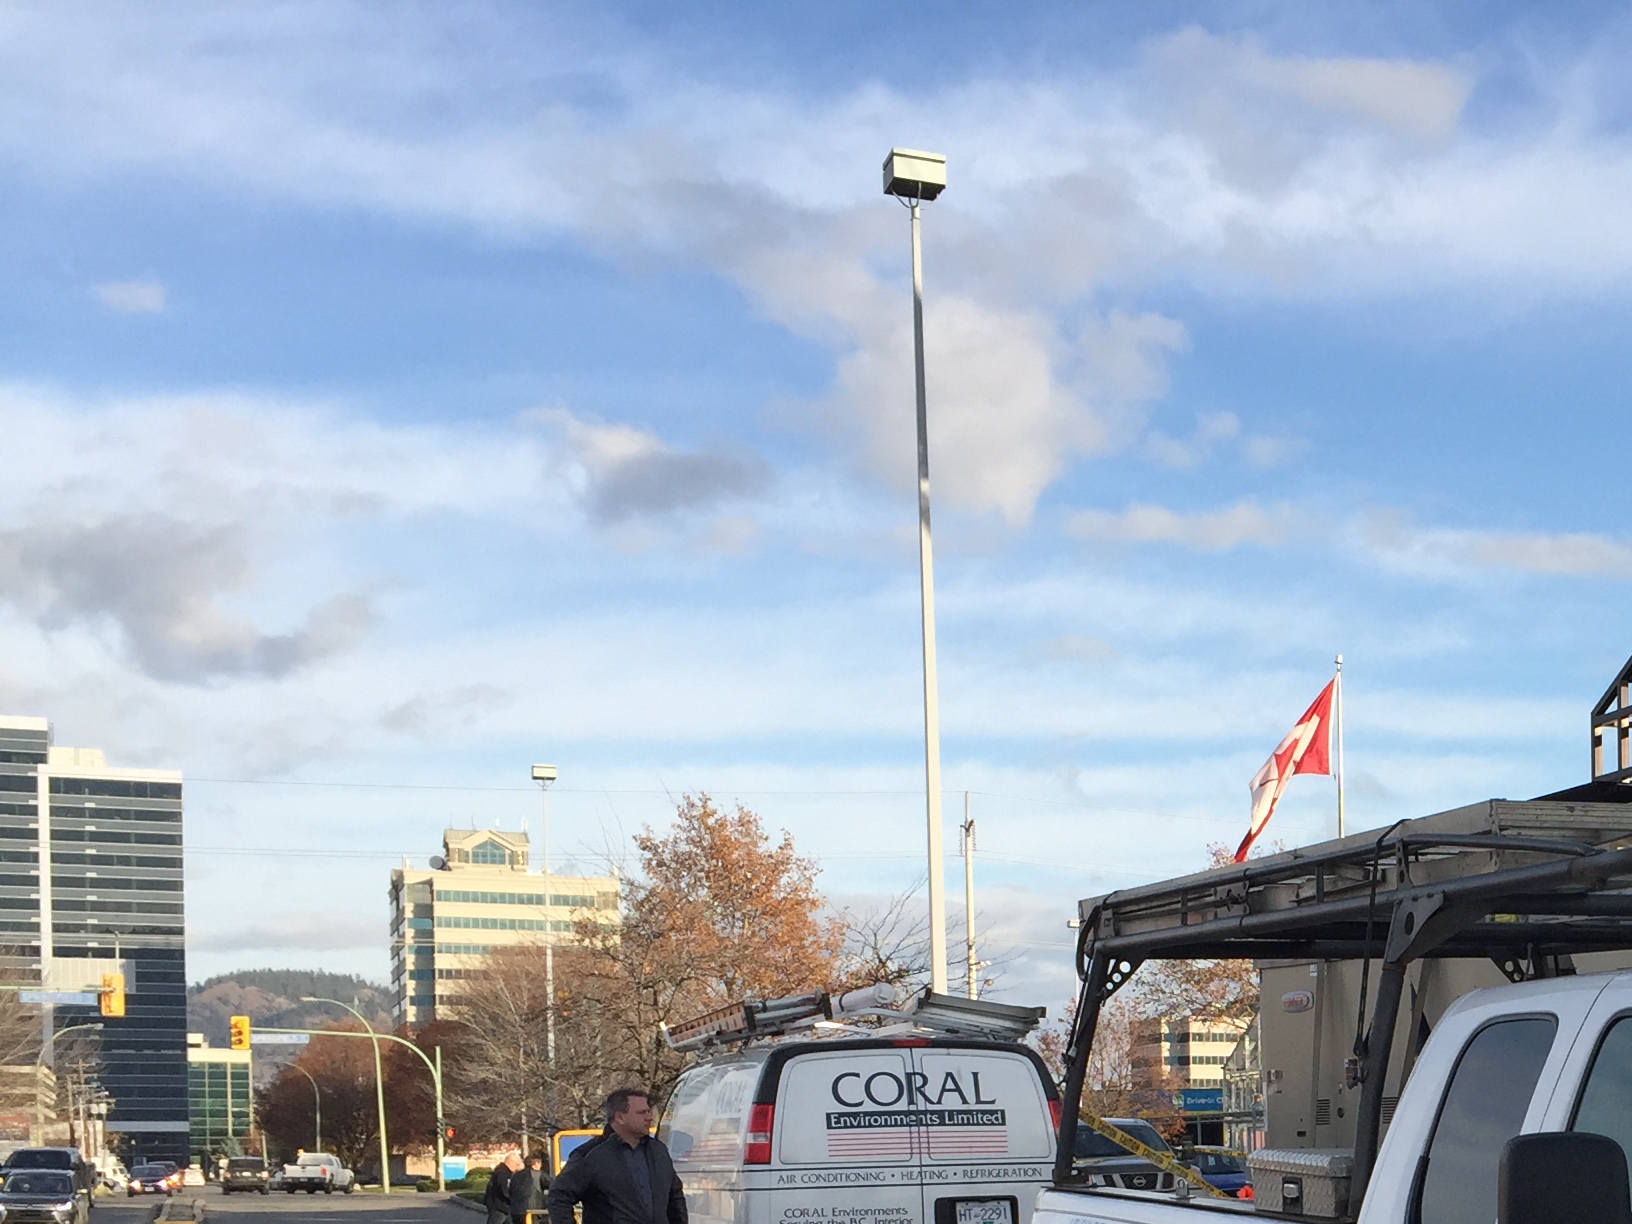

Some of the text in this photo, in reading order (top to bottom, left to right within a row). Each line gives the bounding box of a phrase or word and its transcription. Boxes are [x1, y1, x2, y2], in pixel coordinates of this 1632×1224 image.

[831, 1071, 997, 1108] CORAL
[830, 1110, 1003, 1128] Environments Limited
[777, 1167, 1042, 1185] AIR CONDITIONING HEATING REFRIGERATION
[784, 1206, 908, 1218] CORAL Environments
[980, 1207, 1008, 1221] 2291
